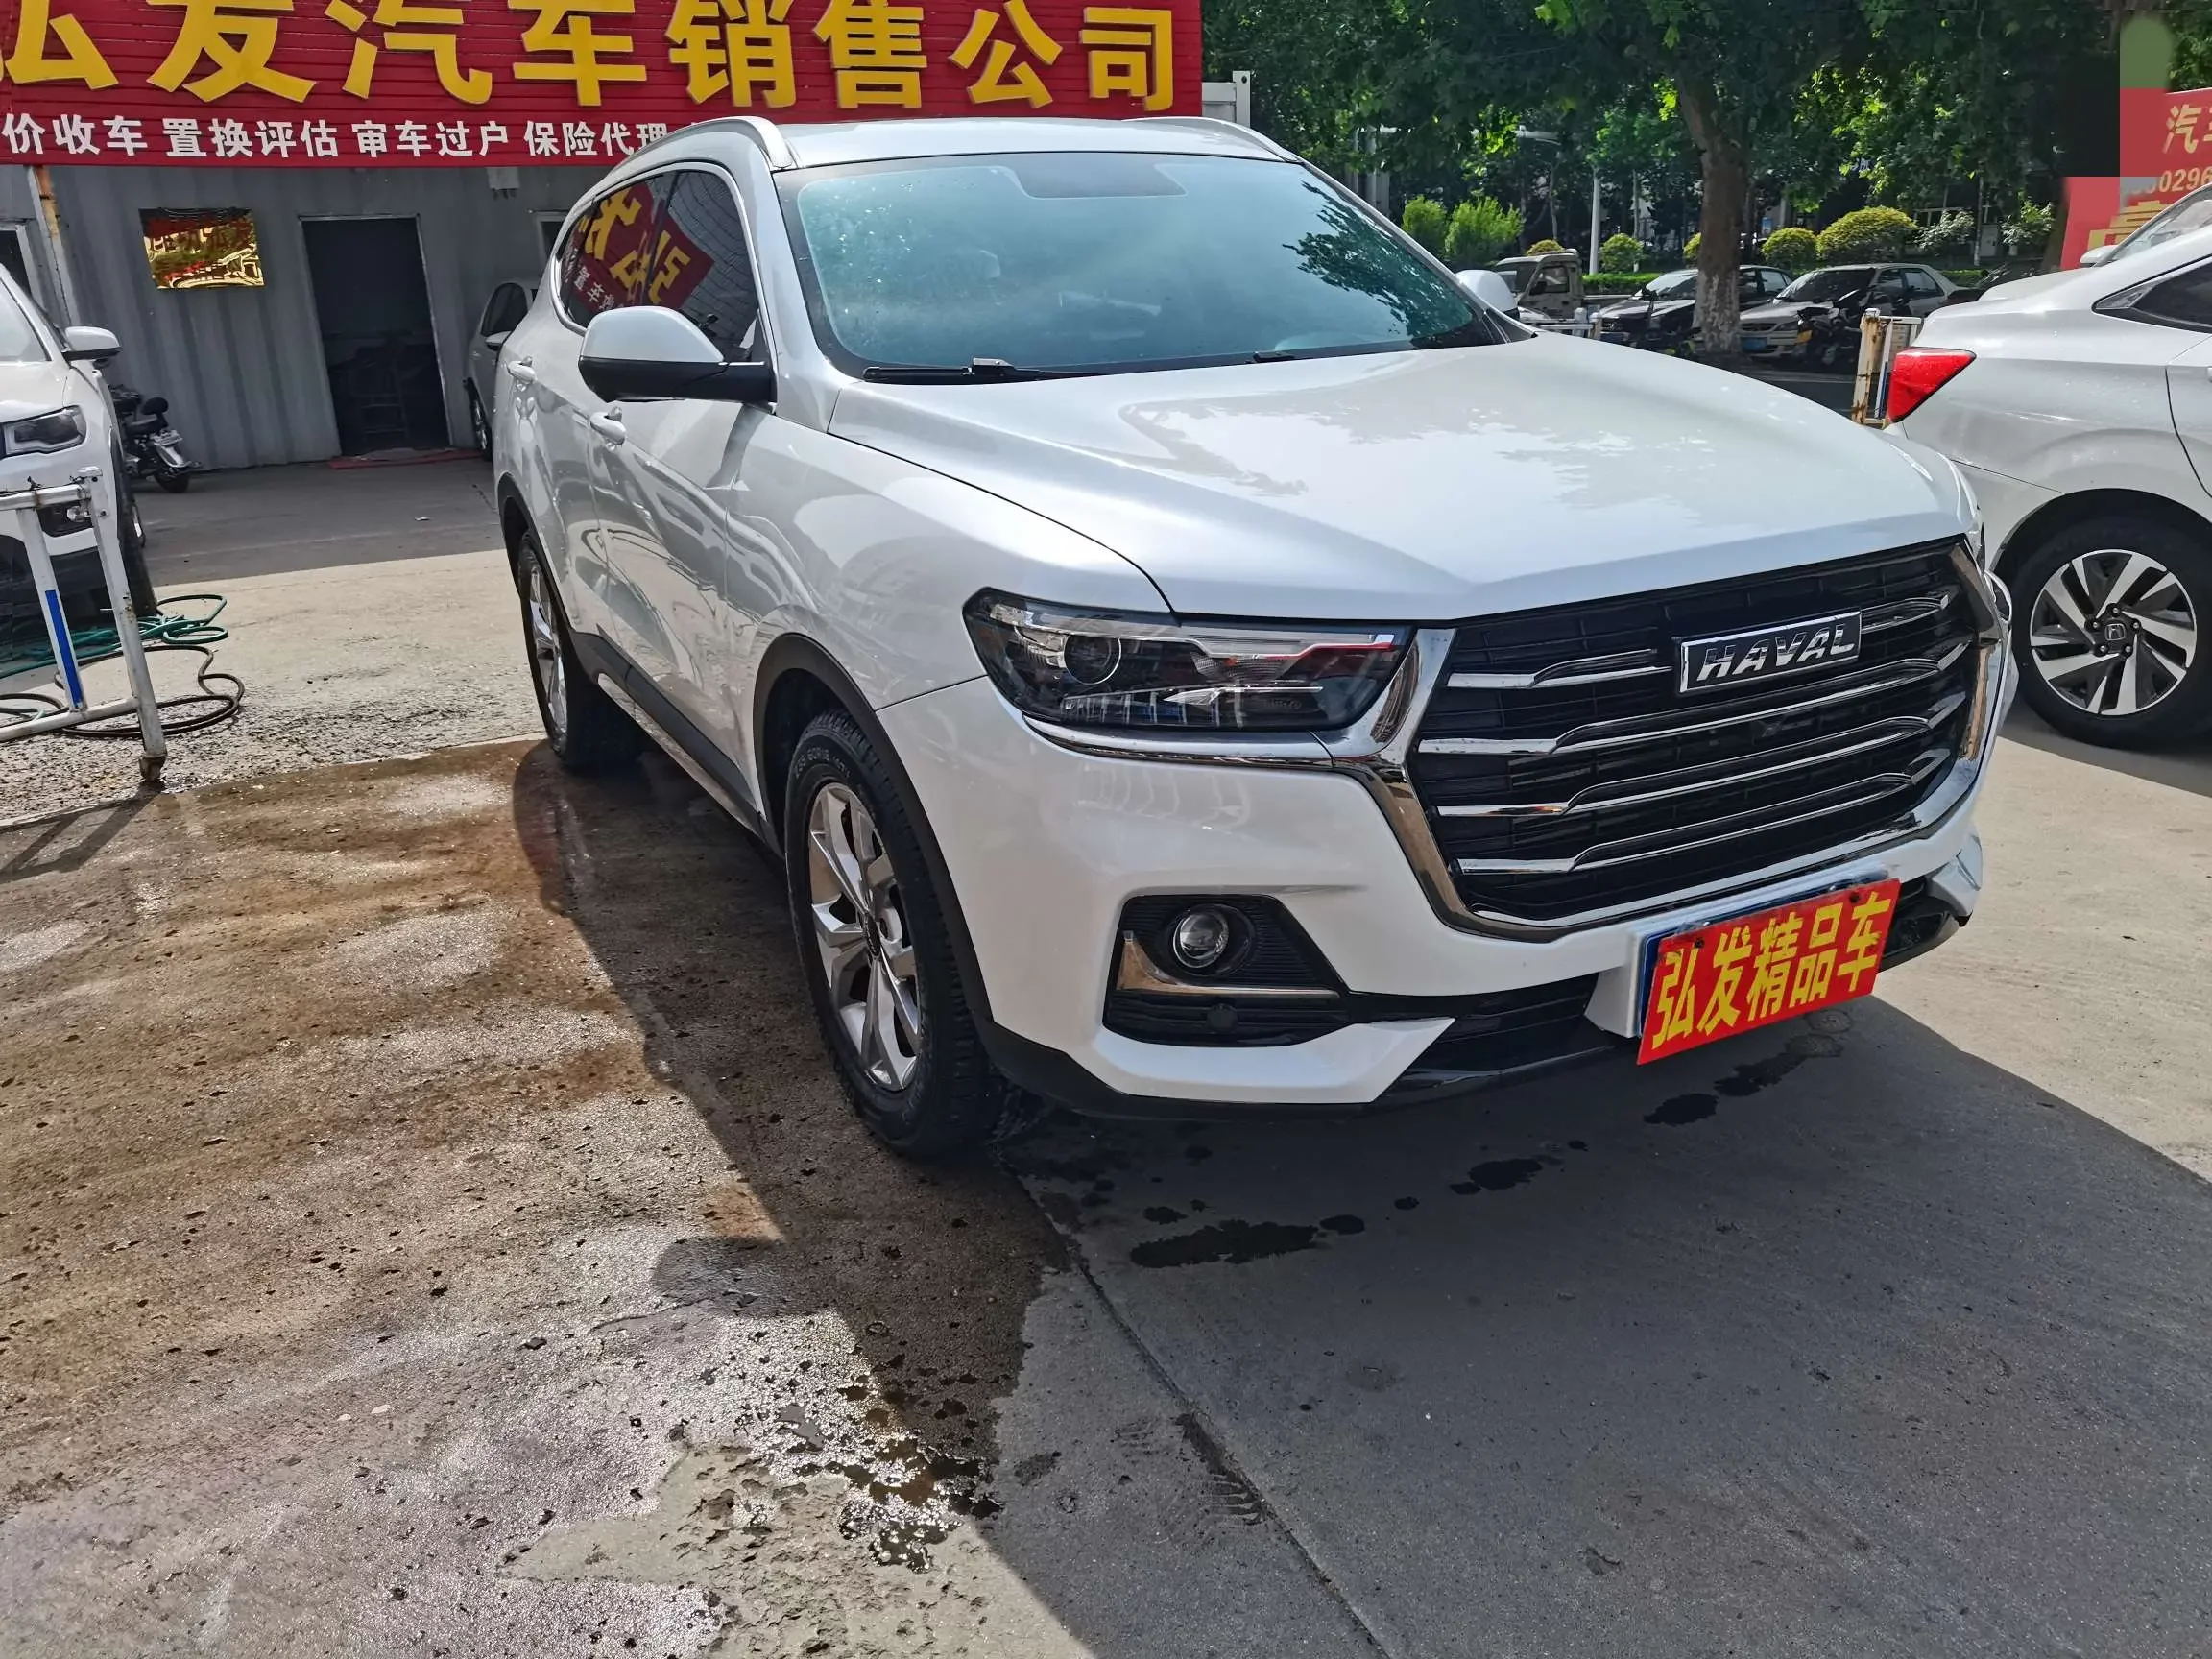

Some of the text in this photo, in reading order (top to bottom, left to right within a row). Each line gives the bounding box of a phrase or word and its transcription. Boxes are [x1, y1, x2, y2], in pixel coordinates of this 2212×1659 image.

[2, 112, 669, 158] 价收车 置换评估 审车过户 保险代理
[1696, 624, 1855, 682] HAVAL
[1651, 891, 1891, 1050] 弘发精品车
